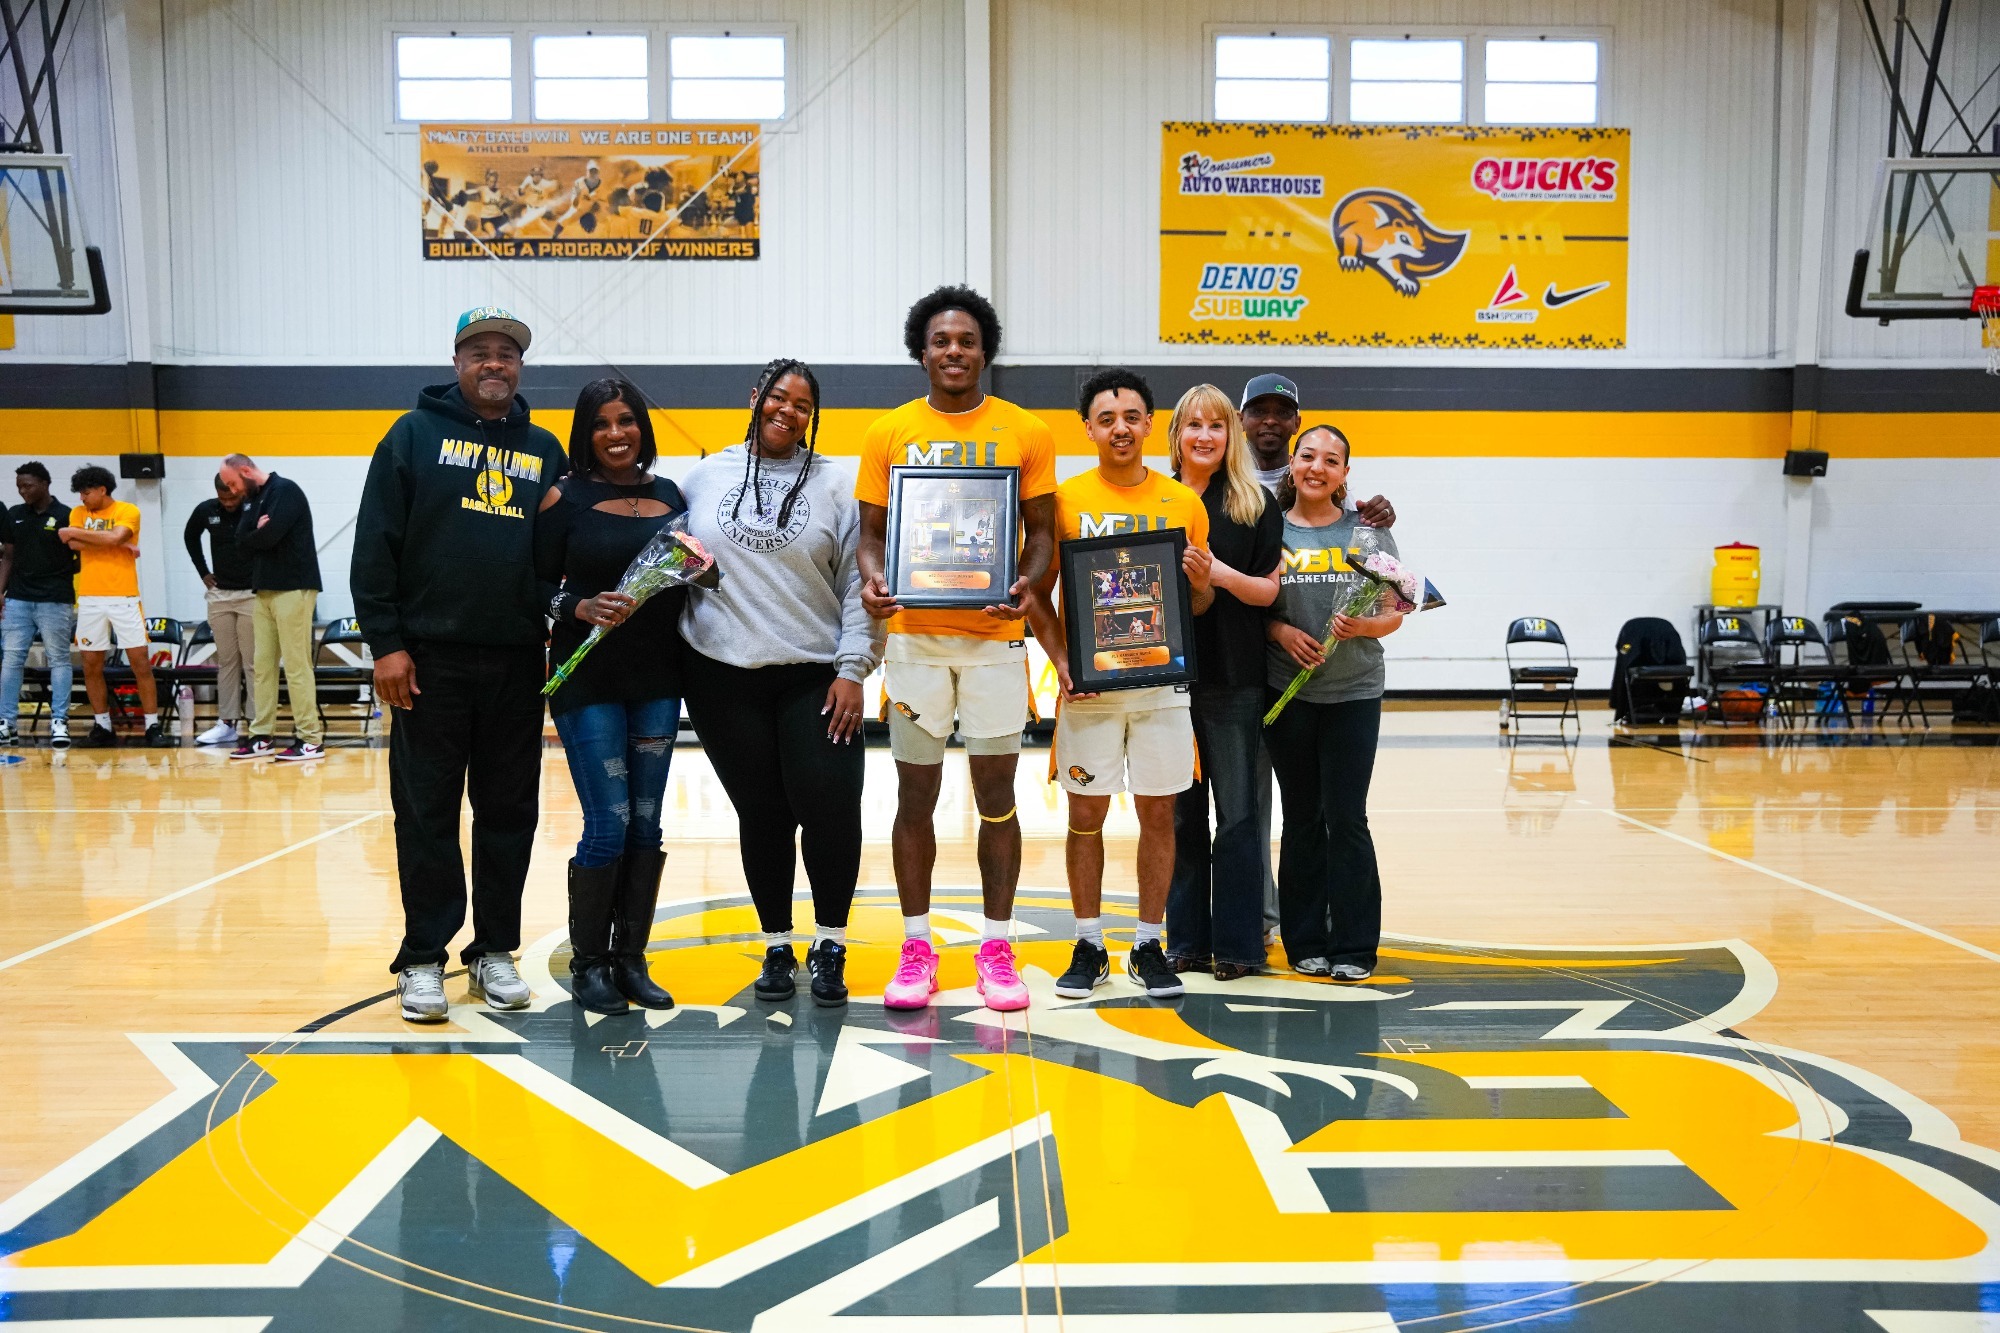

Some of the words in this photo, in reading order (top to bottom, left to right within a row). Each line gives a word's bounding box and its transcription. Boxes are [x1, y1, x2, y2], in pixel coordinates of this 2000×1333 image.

[428, 130, 481, 143] MARY
[485, 130, 570, 143] BALDWIN
[580, 130, 610, 145] WE
[615, 130, 651, 145] ARE
[656, 130, 692, 145] ONE
[697, 130, 753, 145] TEAM!
[467, 145, 530, 153] ATHLETICS
[1198, 155, 1272, 177] Consumers
[1474, 158, 1616, 196] QUICK'S
[1182, 176, 1222, 192] AUTO
[1225, 177, 1321, 194] WAREHOUSE
[429, 242, 515, 257] BUILDING
[519, 242, 535, 257] A
[538, 242, 633, 257] PROGRAM
[637, 242, 662, 257] OF
[665, 242, 754, 257] WINNERS
[1201, 266, 1298, 290] DENO'S
[1193, 298, 1305, 317] SUBWAY
[1500, 312, 1534, 320] SPORTS
[438, 438, 484, 469] MARY
[483, 446, 543, 483] BALDWIN
[461, 497, 525, 519] BASKETBALL
[722, 519, 803, 550] UNIVERSITY
[1280, 573, 1357, 586] BASKETBALL
[146, 619, 167, 631] MB
[1523, 619, 1547, 631] MB
[1716, 618, 1740, 630] MB
[1781, 618, 1805, 630] MB
